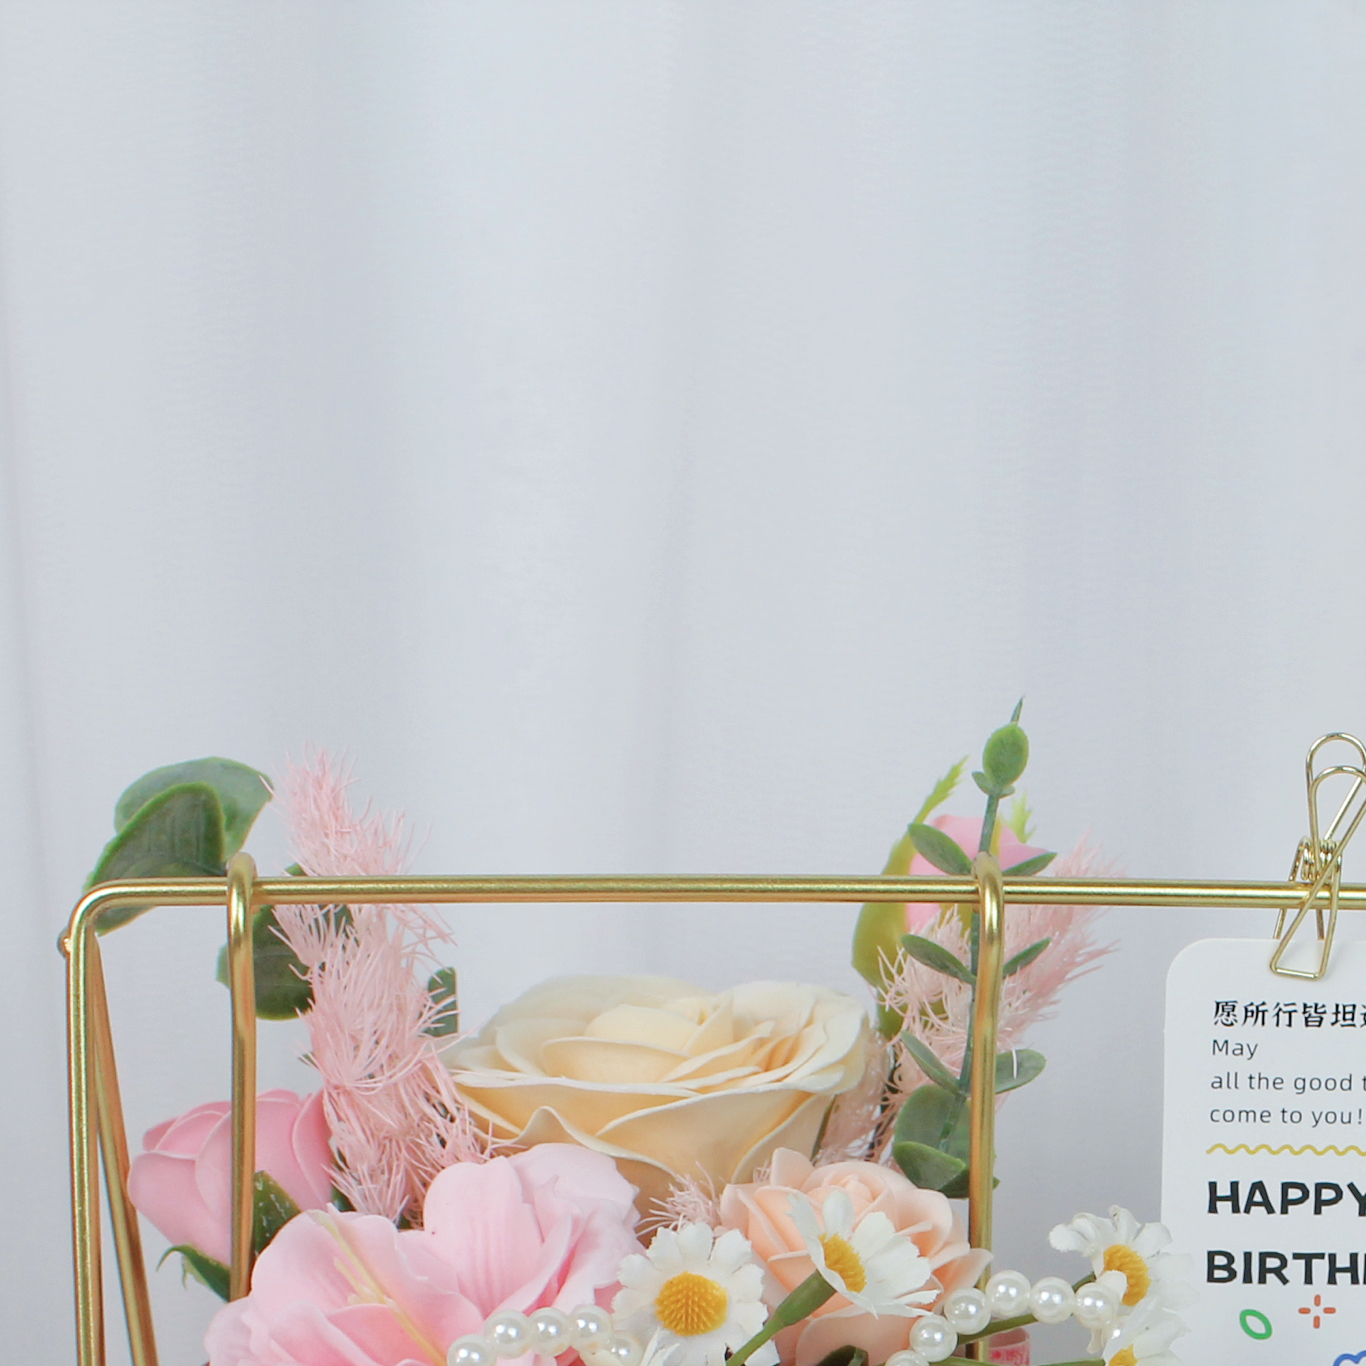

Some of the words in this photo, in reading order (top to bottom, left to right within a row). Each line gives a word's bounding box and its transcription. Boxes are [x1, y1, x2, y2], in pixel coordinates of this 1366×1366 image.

[1212, 1039, 1258, 1061] May
[1210, 1072, 1239, 1090] all
[1248, 1072, 1285, 1090] the
[1293, 1073, 1353, 1095] good
[1209, 1109, 1272, 1124] come
[1281, 1108, 1303, 1124] to
[1311, 1108, 1363, 1128] you!
